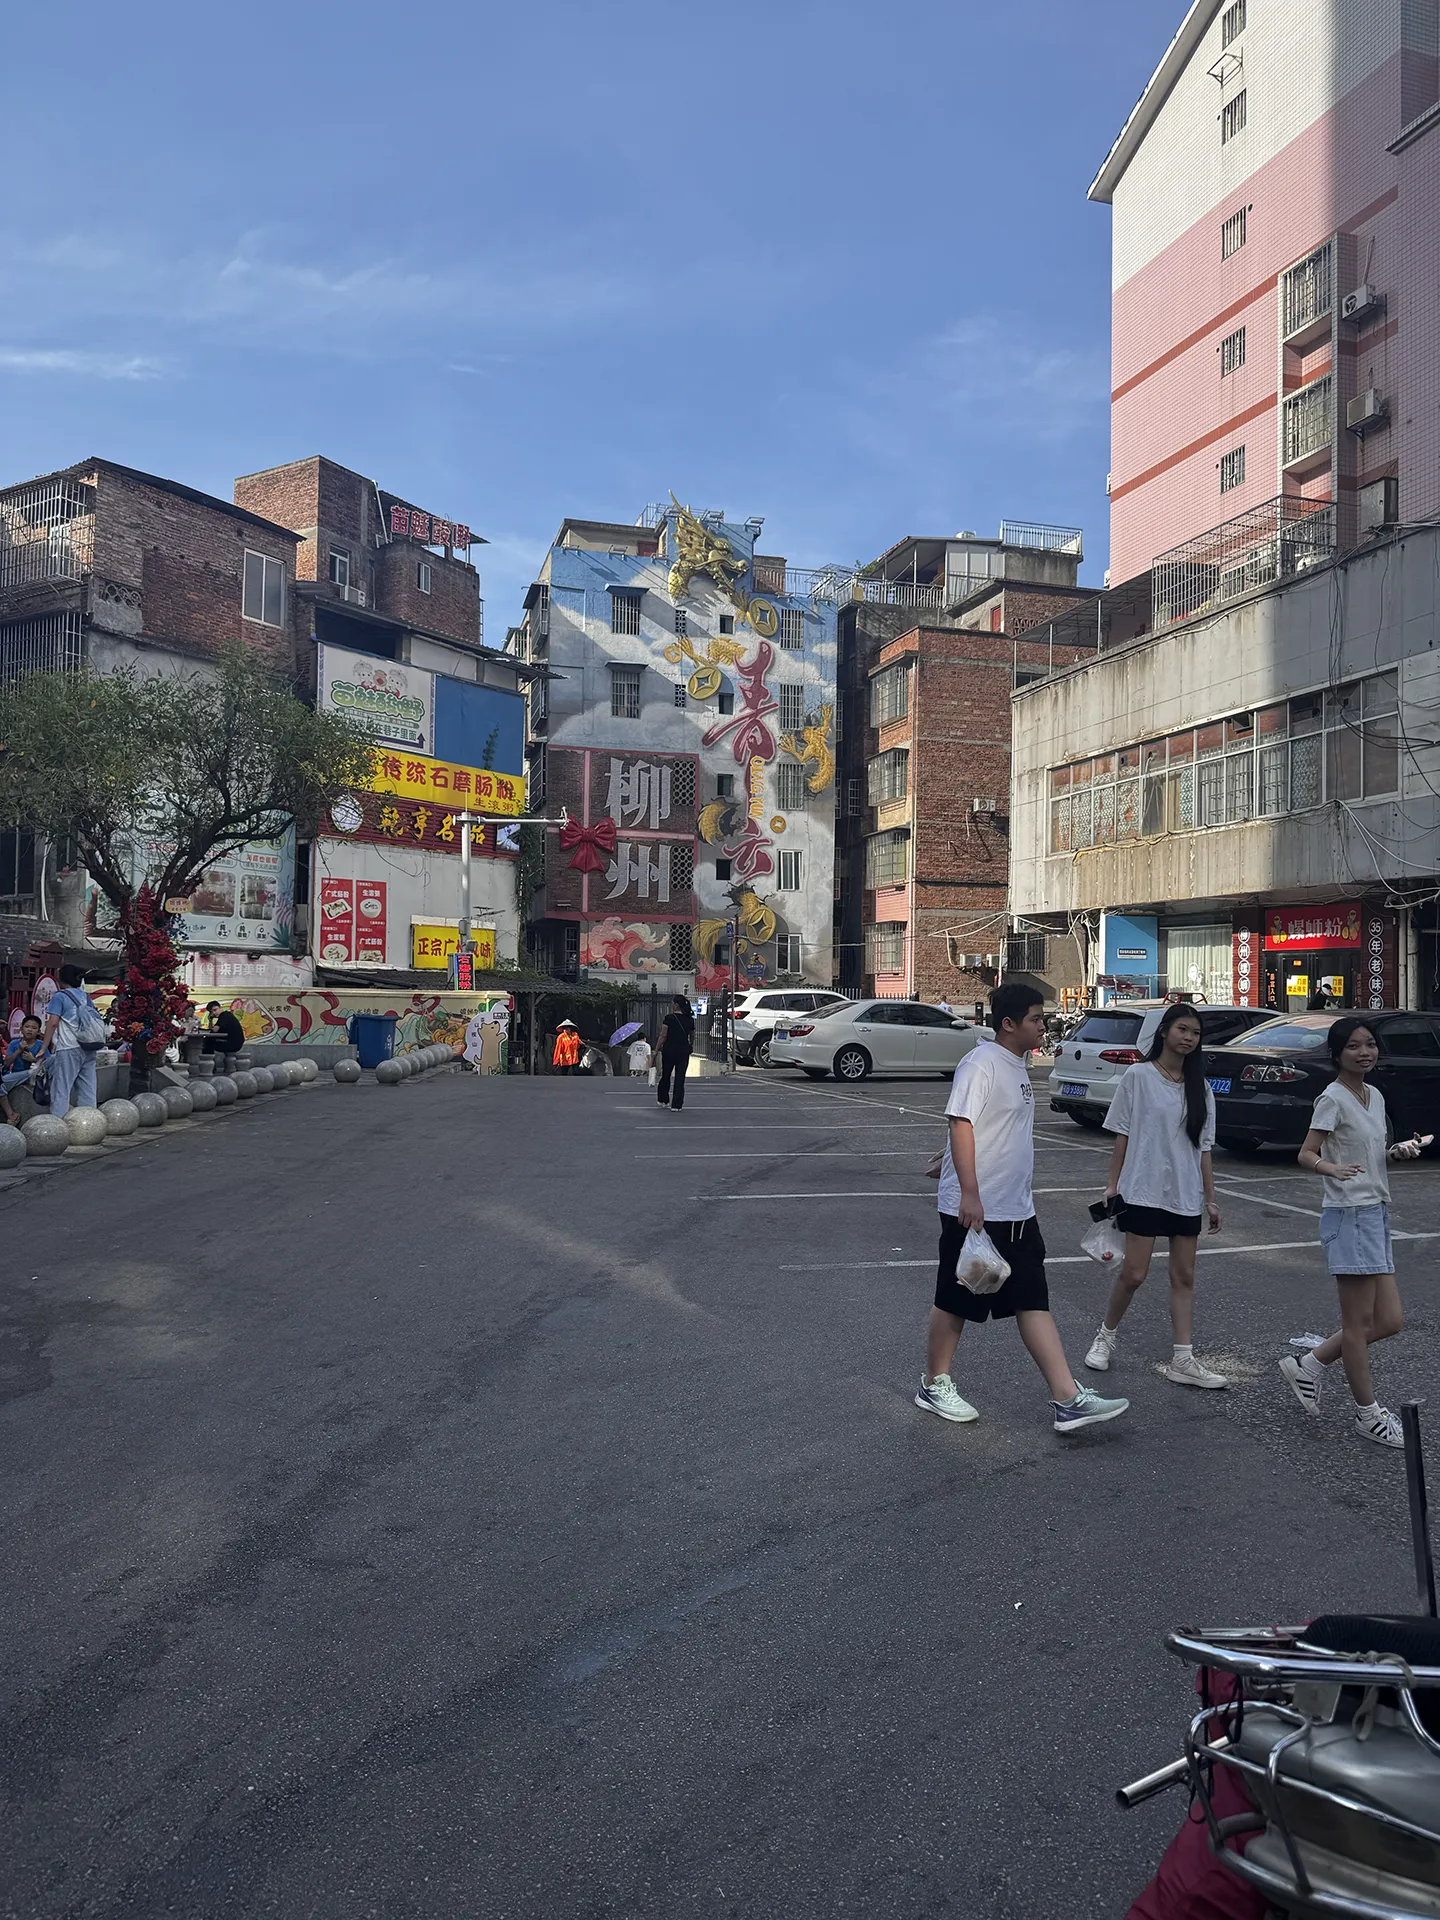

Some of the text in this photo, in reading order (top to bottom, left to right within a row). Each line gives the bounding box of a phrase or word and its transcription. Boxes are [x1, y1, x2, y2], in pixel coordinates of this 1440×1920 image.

[473, 797, 514, 812] 生滚粥
[604, 757, 673, 903] 柳州
[1288, 917, 1343, 940] 螺蛳粉
[458, 955, 472, 990] 石磨肠粉
